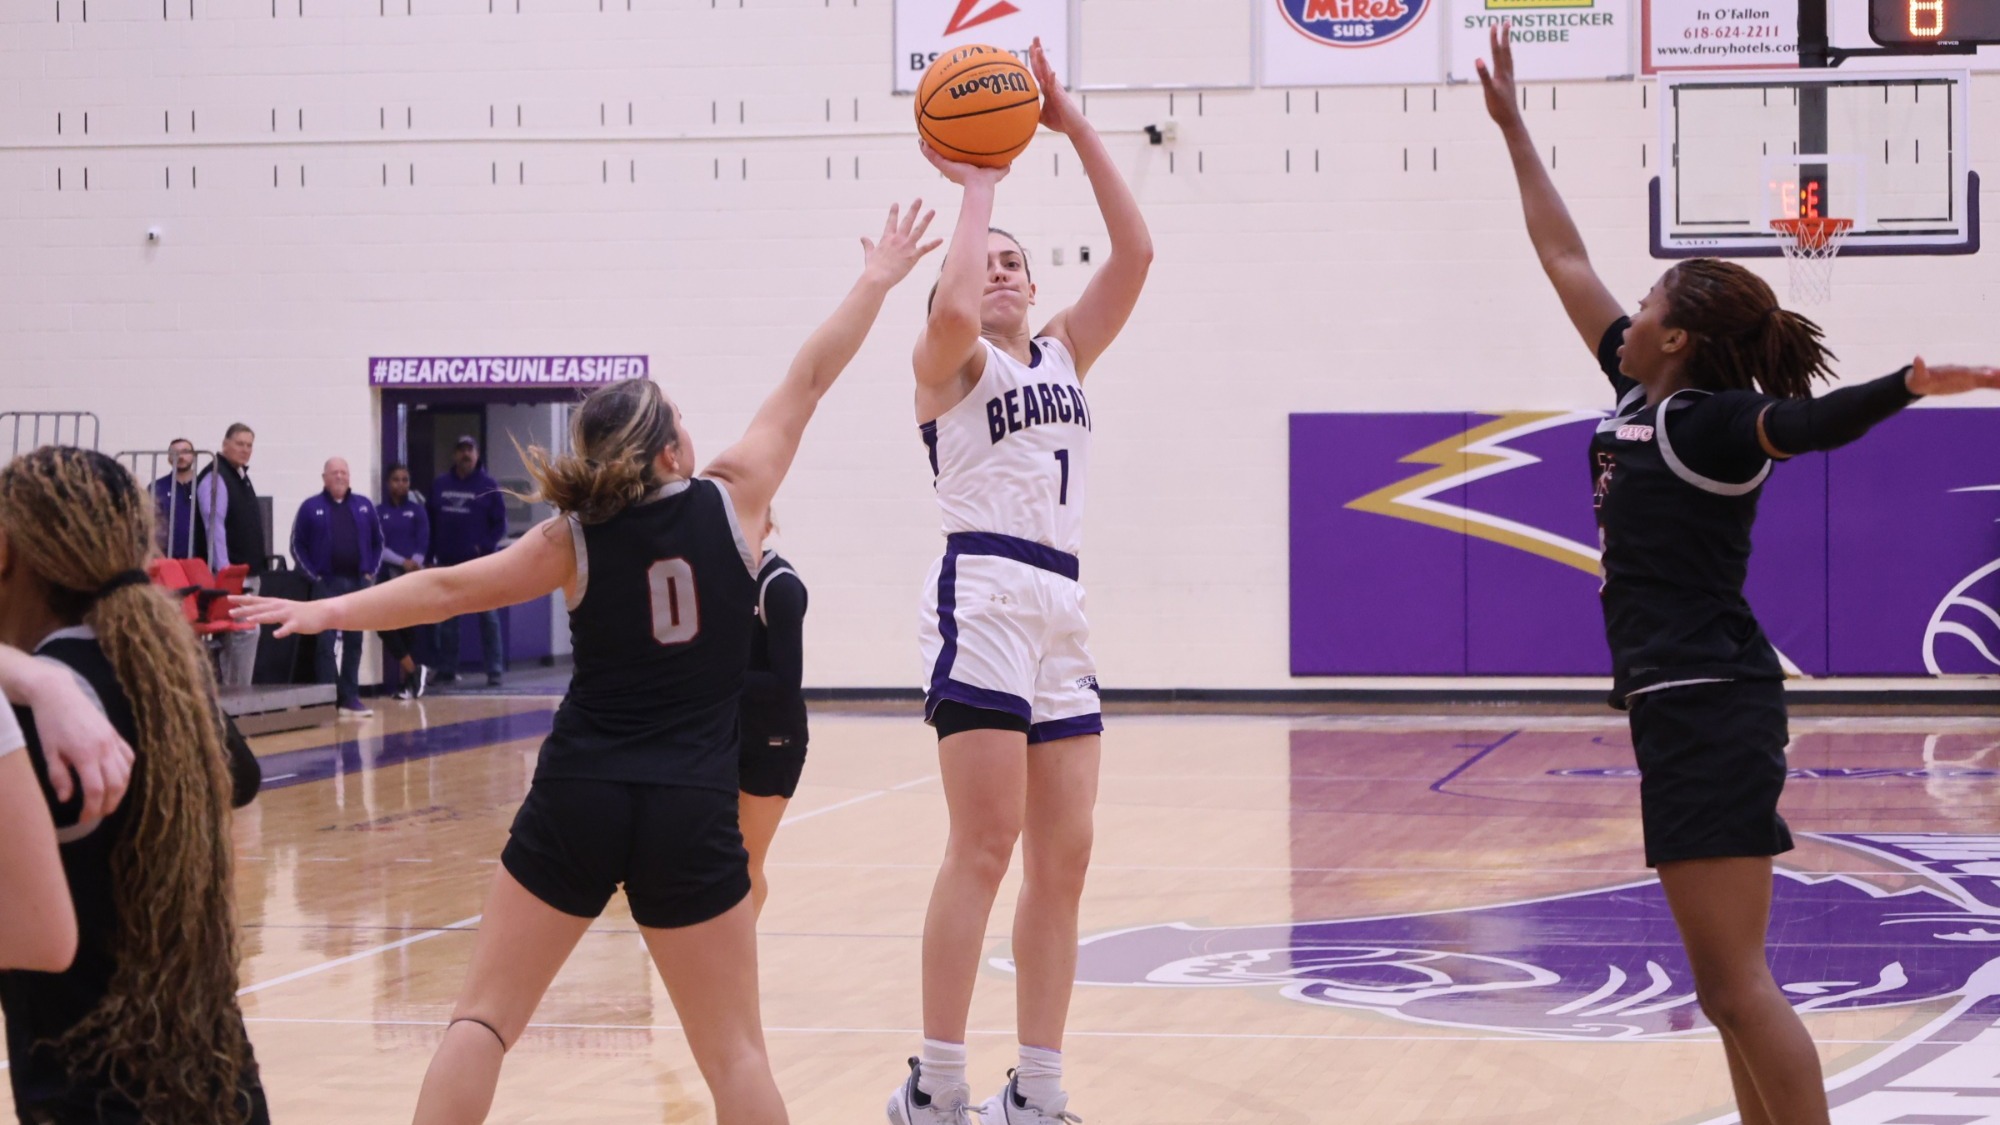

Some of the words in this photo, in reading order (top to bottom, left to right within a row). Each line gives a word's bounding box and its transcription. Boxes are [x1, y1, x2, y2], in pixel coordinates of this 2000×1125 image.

[1464, 13, 1614, 28] SYDENSTRICKER
[1697, 10, 1710, 20] In
[1715, 9, 1769, 20] O'Fallon
[1332, 24, 1375, 37] SUBS
[1509, 29, 1570, 43] NOBBE
[1683, 25, 1779, 39] 618-624-2211
[949, 72, 1030, 99] Wilson
[373, 357, 644, 383] #BEARCATSUNLEASHED
[1053, 449, 1069, 505] 1
[647, 556, 701, 645] 0
